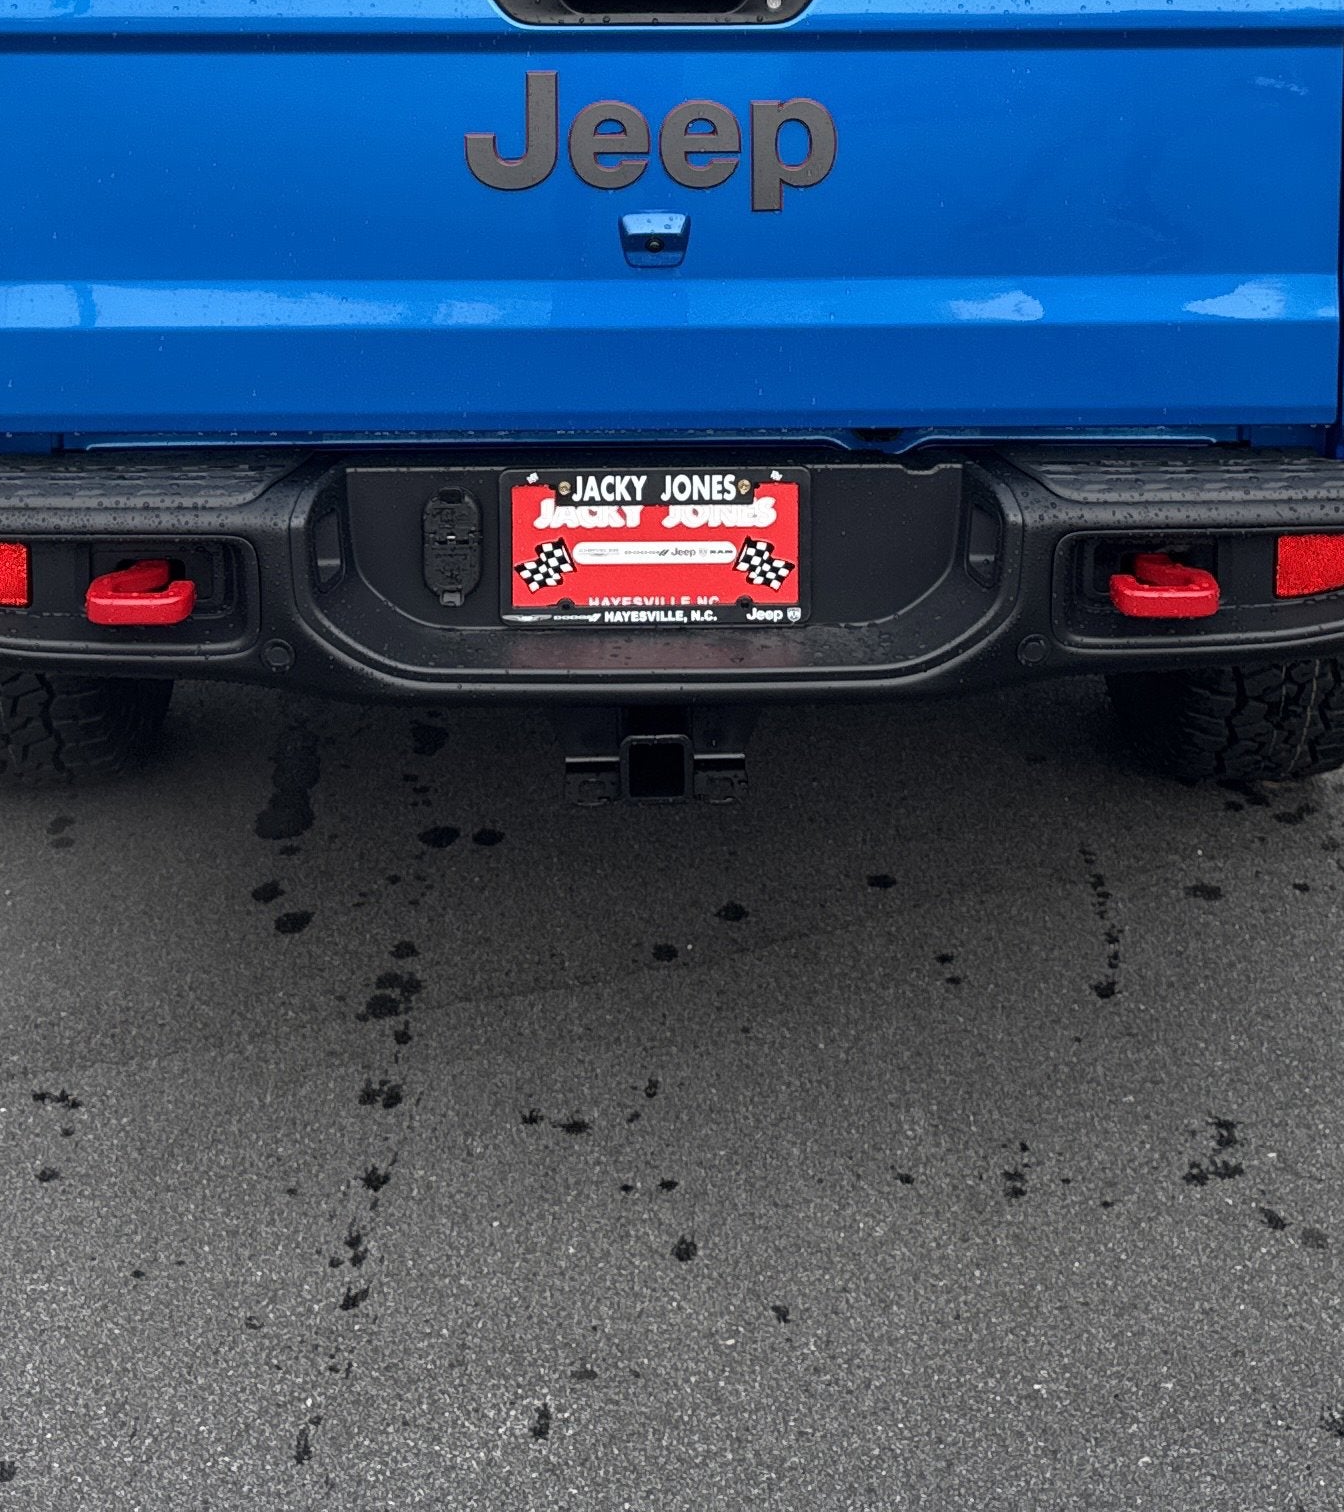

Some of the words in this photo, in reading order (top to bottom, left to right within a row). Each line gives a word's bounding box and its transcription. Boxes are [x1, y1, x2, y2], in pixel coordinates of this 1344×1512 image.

[463, 70, 838, 213] Jeep
[572, 475, 647, 502] JACKY
[660, 474, 736, 501] JONES
[533, 498, 644, 529] JACKY
[661, 496, 777, 529] JONES
[671, 548, 696, 558] Jeep
[604, 610, 687, 623] HAYESVILLE,
[691, 609, 717, 622] N.C.
[747, 607, 783, 622] Jeep
